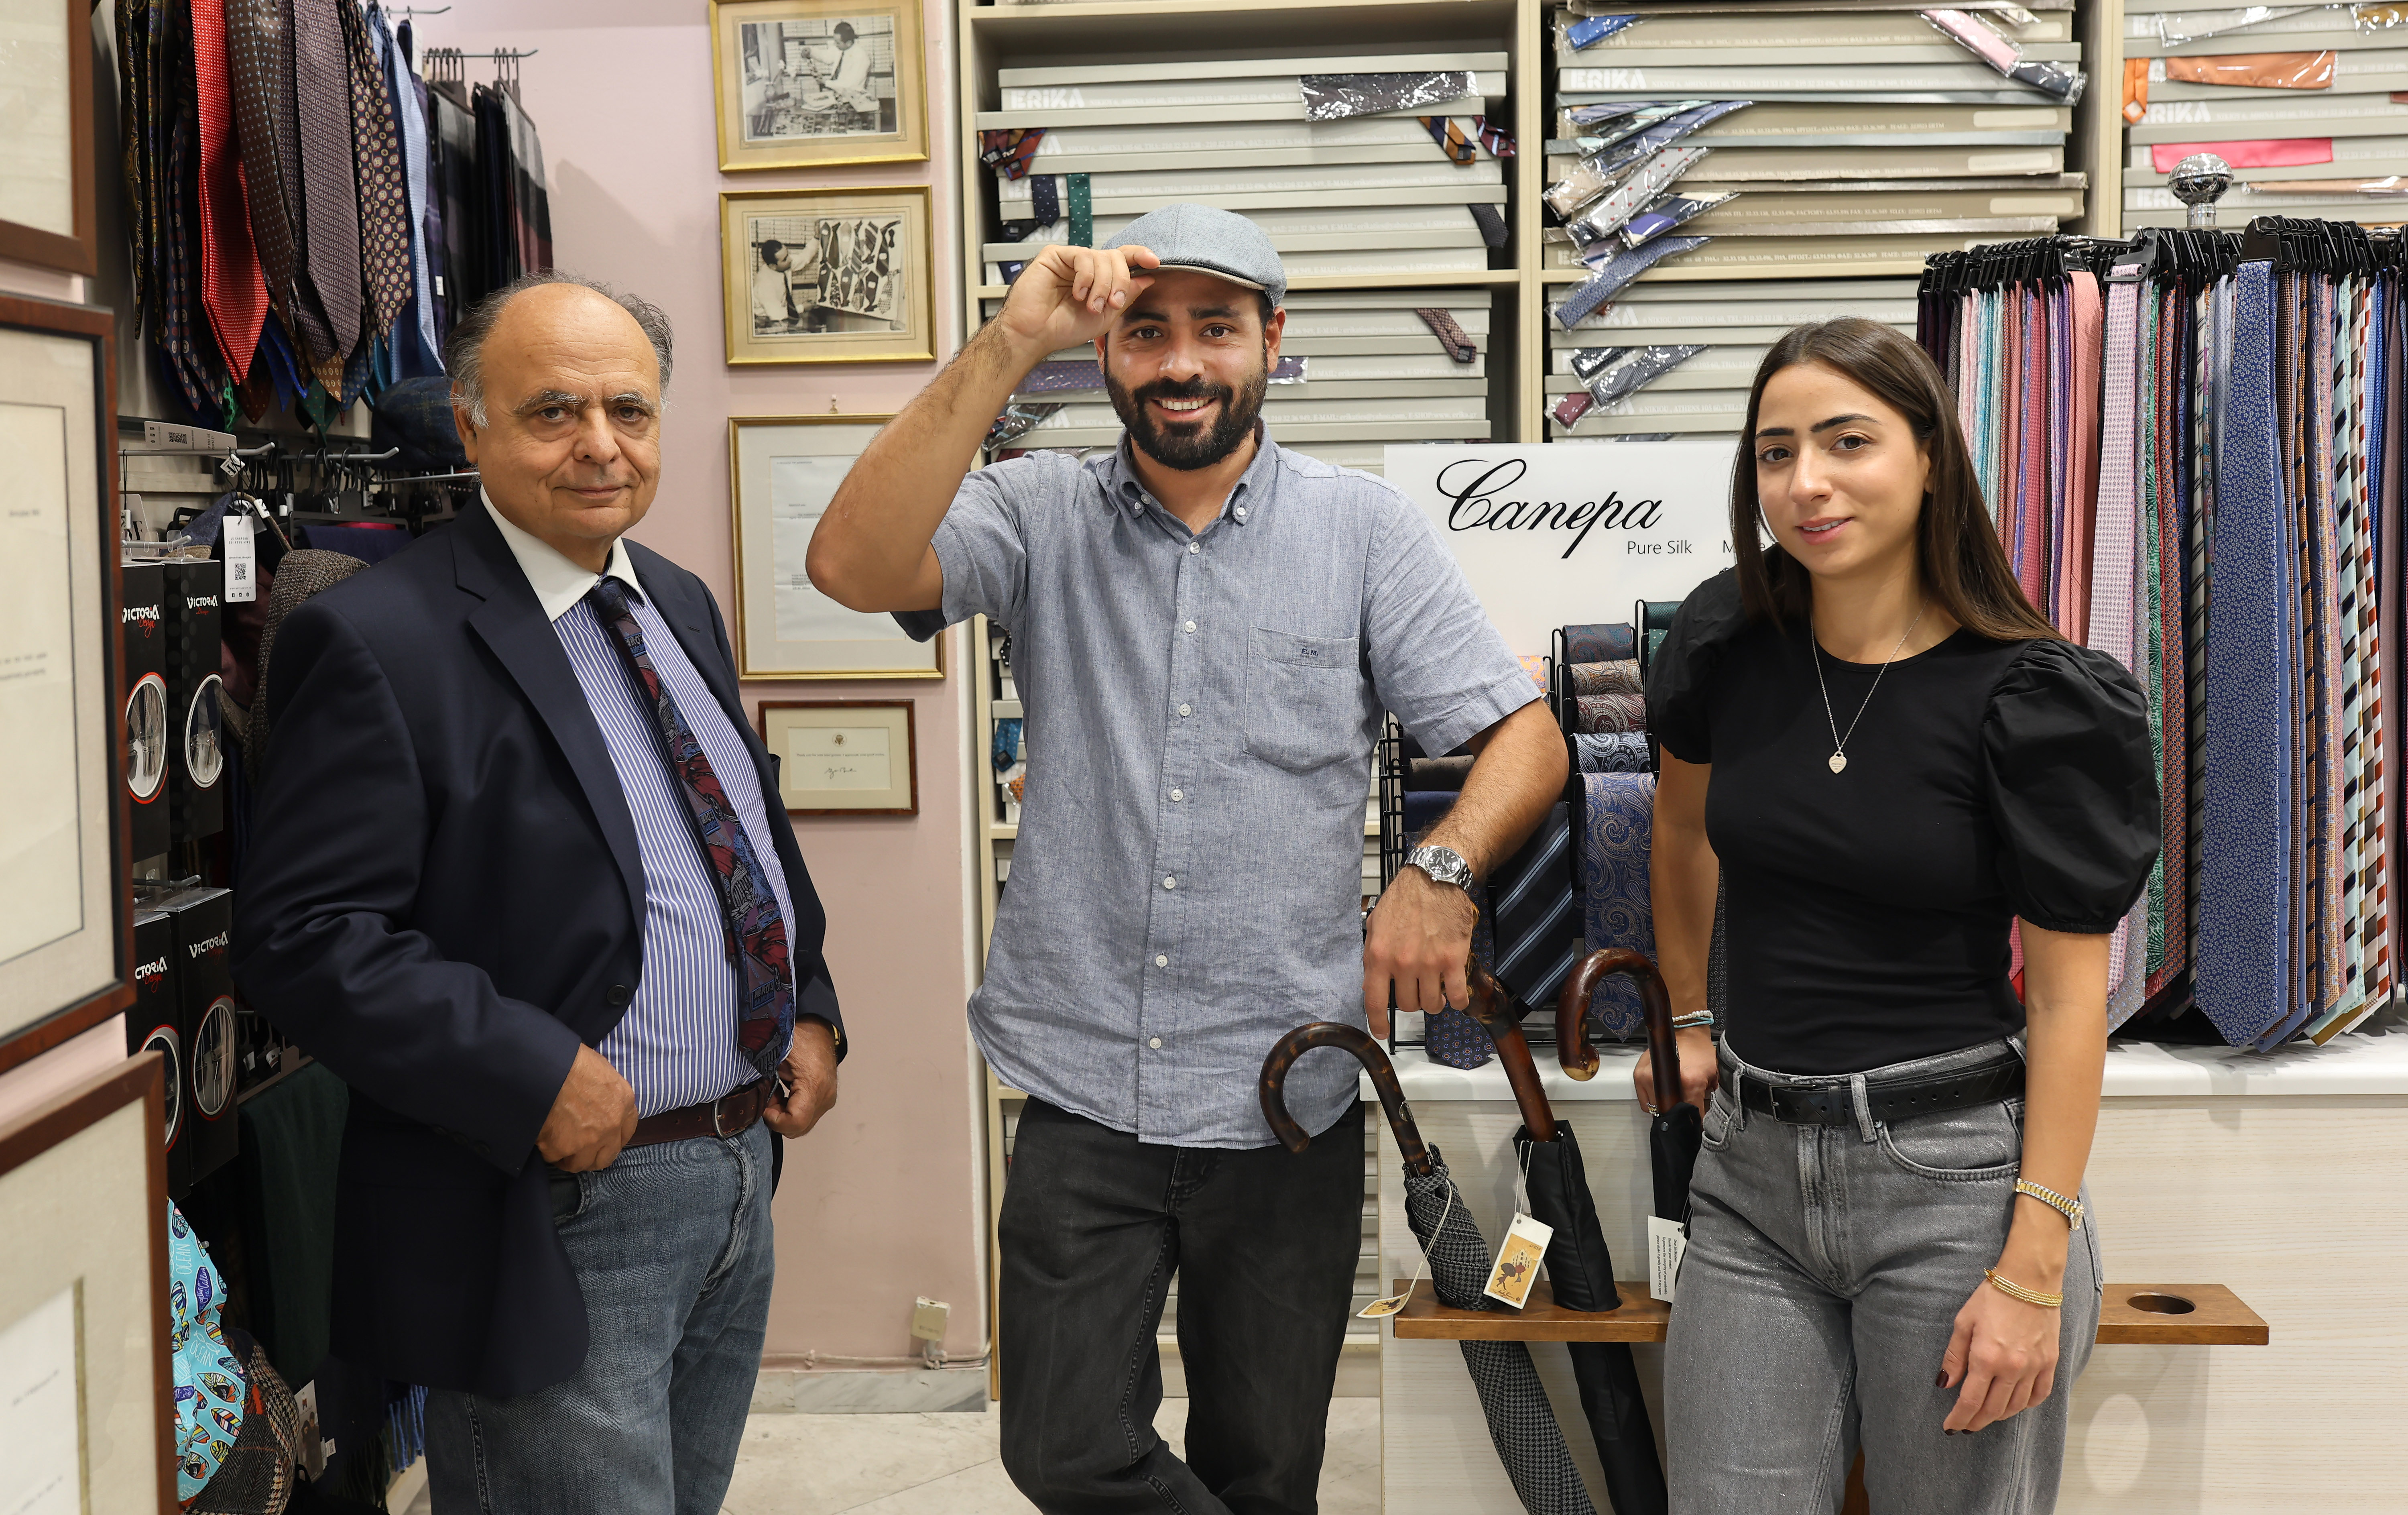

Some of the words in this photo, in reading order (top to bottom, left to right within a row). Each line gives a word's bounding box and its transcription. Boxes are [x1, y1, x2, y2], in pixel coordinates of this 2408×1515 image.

[1436, 458, 1663, 559] Canepa
[1627, 540, 1662, 555] Pure
[1667, 540, 1692, 554] Silk
[190, 1340, 214, 1367] OCEAN
